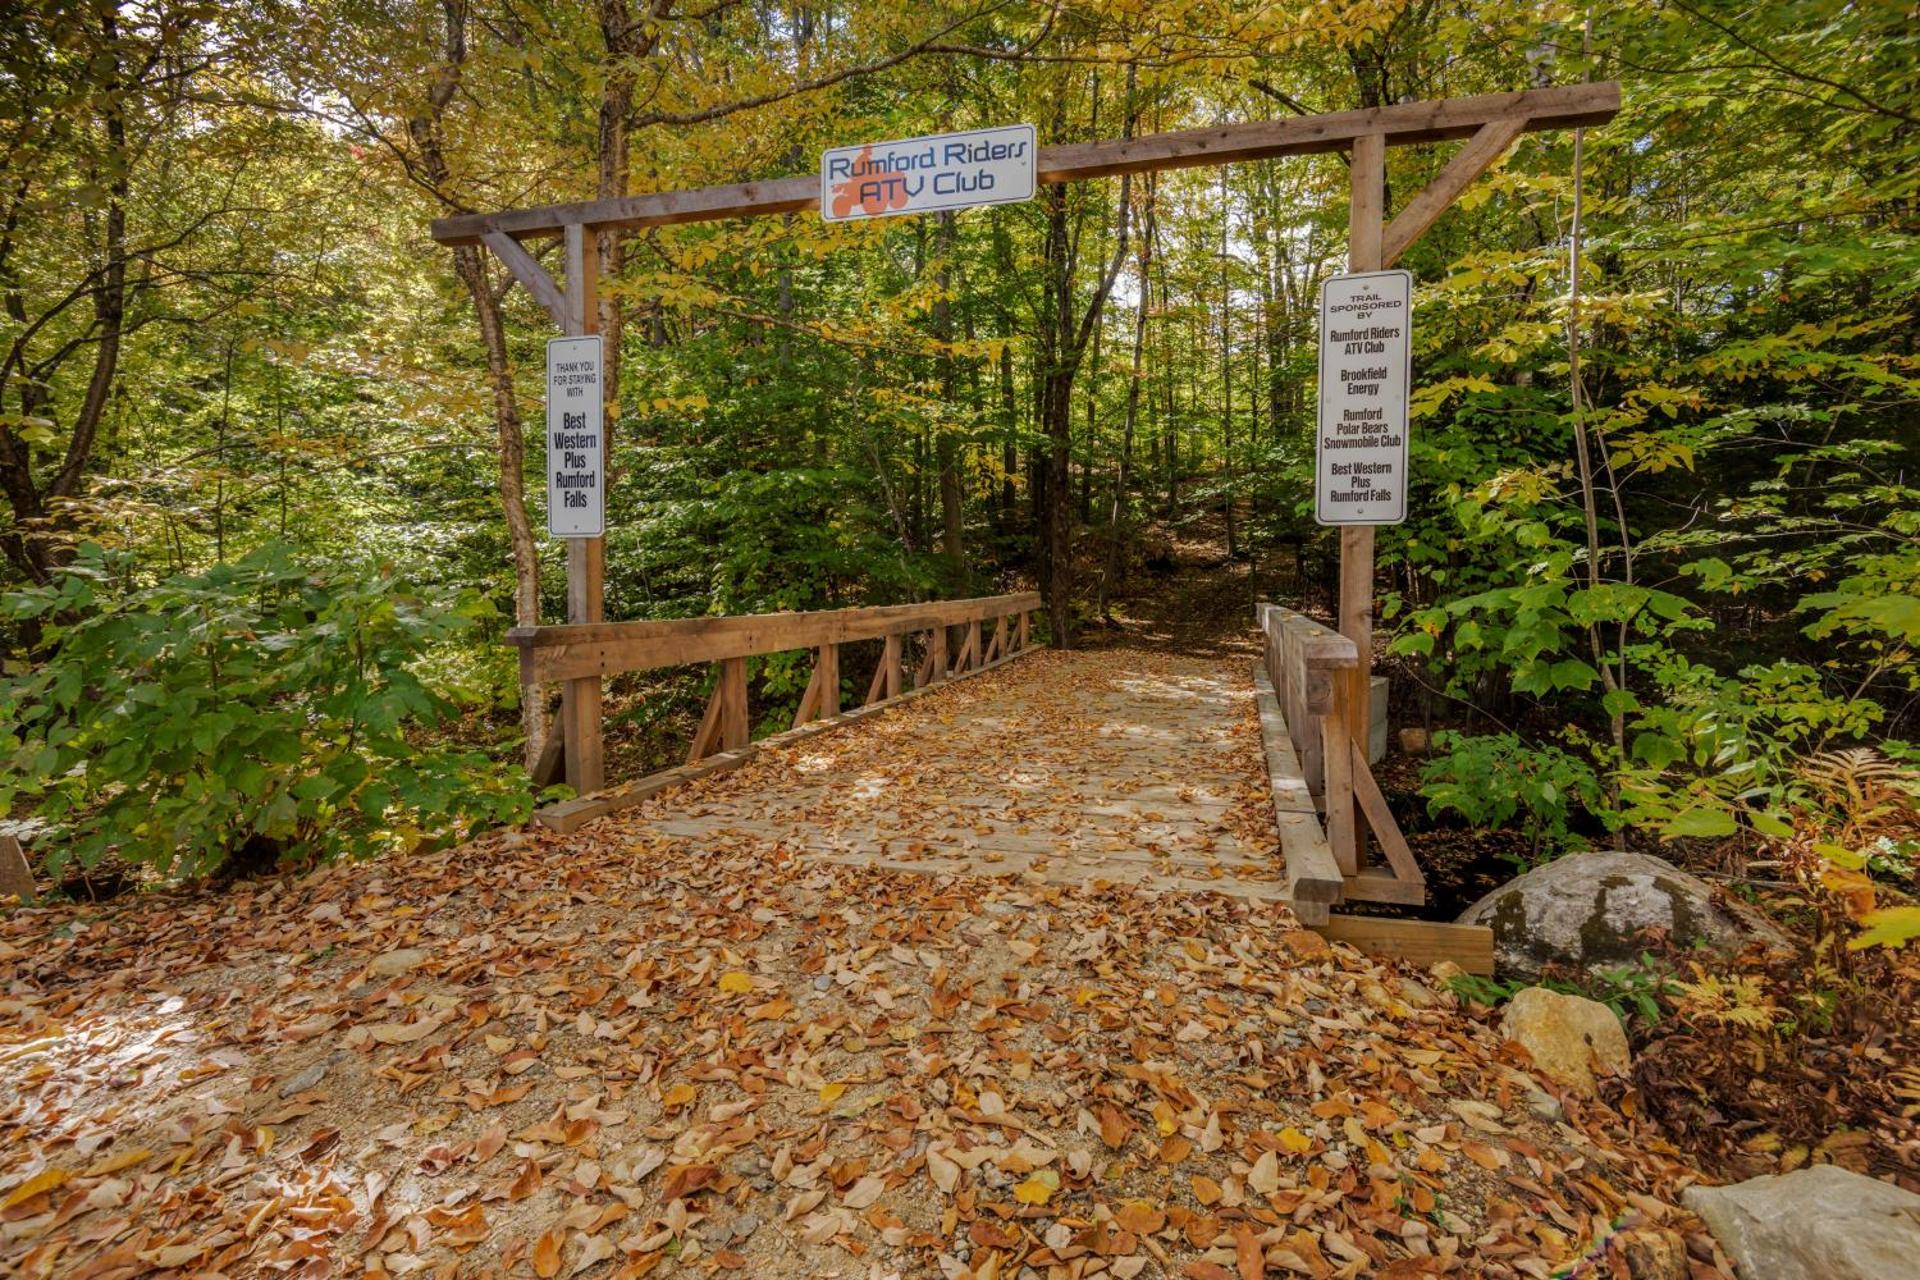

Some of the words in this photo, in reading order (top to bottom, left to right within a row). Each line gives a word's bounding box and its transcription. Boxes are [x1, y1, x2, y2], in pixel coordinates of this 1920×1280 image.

[830, 147, 936, 180] Rumford
[944, 140, 1027, 166] Riders
[860, 175, 924, 203] ATV
[934, 169, 995, 195] Club
[1350, 294, 1381, 303] TRAIL
[1330, 300, 1401, 313] SPONSORED
[1357, 312, 1372, 320] BY
[1330, 328, 1369, 343] Rumford
[1370, 326, 1400, 339] Riders
[1345, 342, 1363, 355] ATV
[1364, 341, 1384, 353] Club
[556, 362, 578, 373] THANK
[580, 361, 594, 371] YOU
[1340, 367, 1387, 381] Brookfield
[554, 375, 567, 385] FOR
[568, 373, 596, 384] STAYING
[567, 387, 583, 397] WITH
[1348, 382, 1379, 396] Energy
[564, 412, 586, 430] Best
[1343, 407, 1382, 422] Rumford
[1337, 421, 1360, 435] Polar
[1362, 421, 1388, 434] Bears
[554, 432, 596, 450] Western
[1324, 435, 1379, 449] Snowmobile
[1381, 434, 1401, 446] Club
[565, 452, 586, 469] Plus
[1331, 462, 1352, 475] Best
[1353, 462, 1391, 474] Western
[556, 471, 594, 489] Rumford
[1351, 475, 1370, 488] Plus
[564, 491, 586, 508] Falls
[1330, 489, 1369, 502] Rumford
[1370, 488, 1391, 501] Falls
